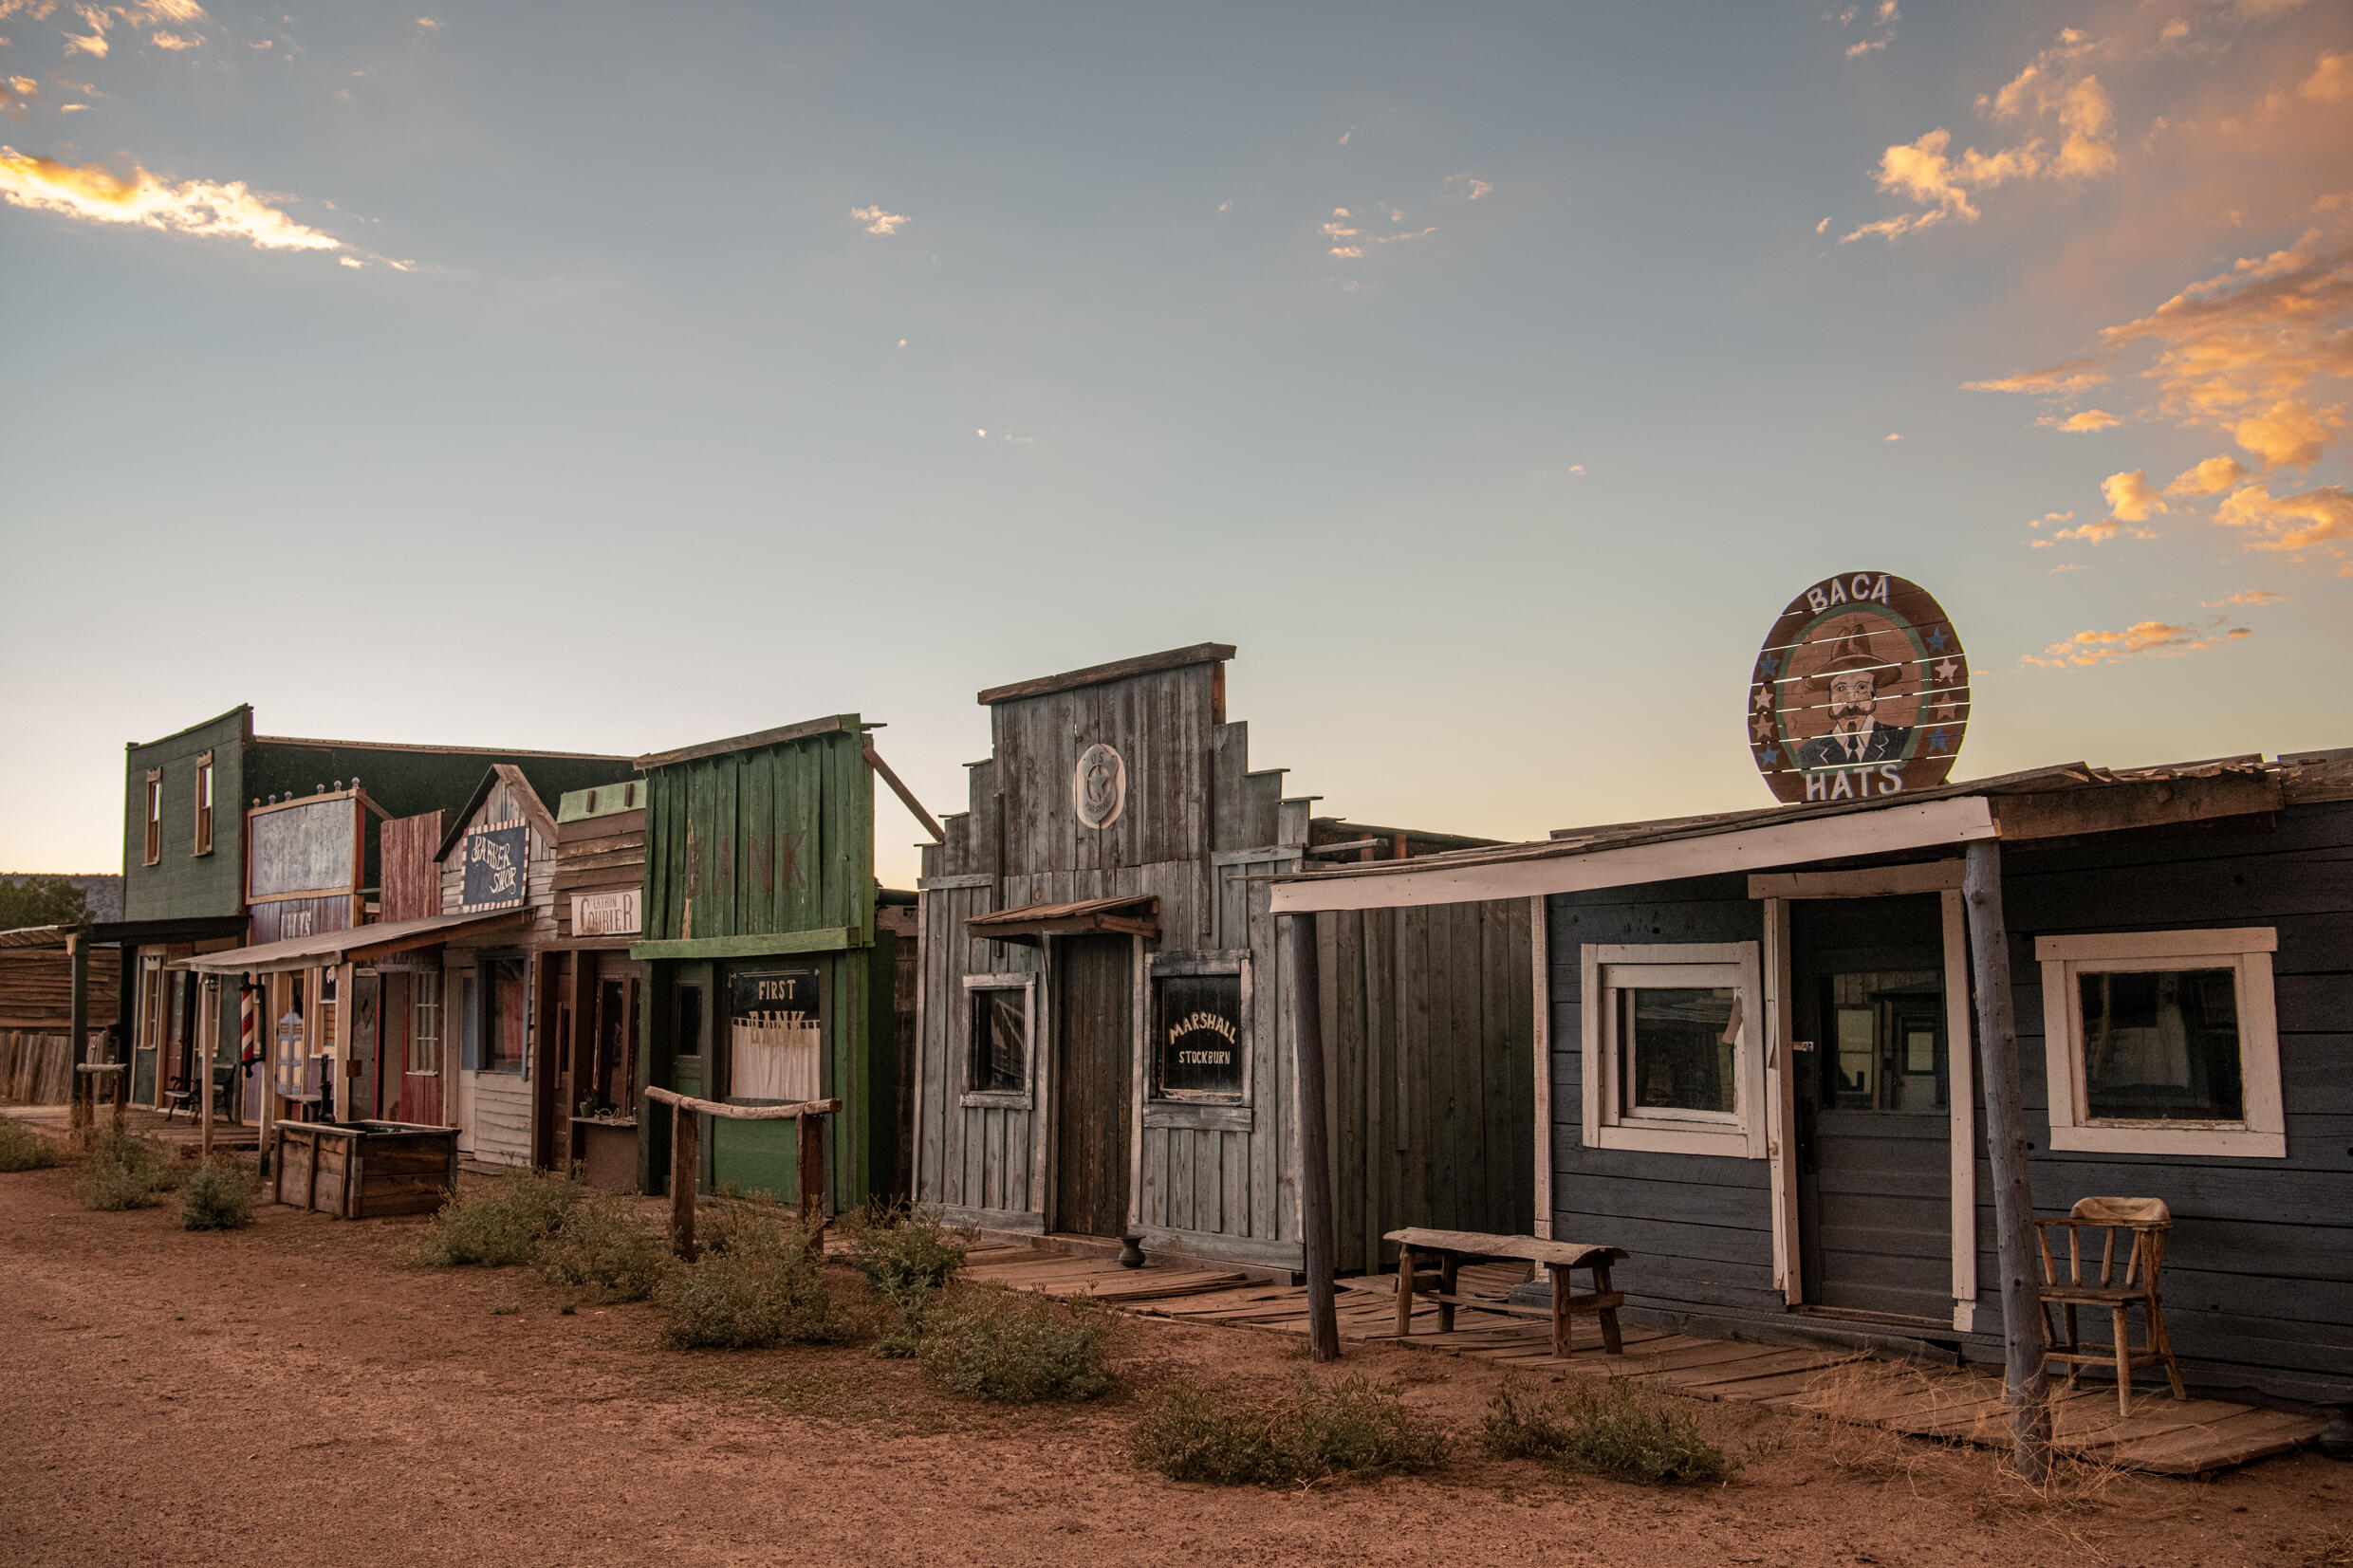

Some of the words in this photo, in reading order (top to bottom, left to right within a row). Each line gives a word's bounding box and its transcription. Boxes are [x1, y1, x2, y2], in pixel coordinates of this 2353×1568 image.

[1806, 573, 1891, 616] BACA
[1806, 764, 1903, 802] HATS
[471, 836, 512, 871] BARBER
[685, 826, 806, 899] BANK
[489, 867, 517, 895] SHOP
[580, 894, 634, 933] COURIER
[758, 979, 797, 1001] FIRST
[748, 1009, 807, 1049] BANK
[1168, 1010, 1237, 1045] MARSHALL
[1178, 1049, 1232, 1065] STOCKBURN
